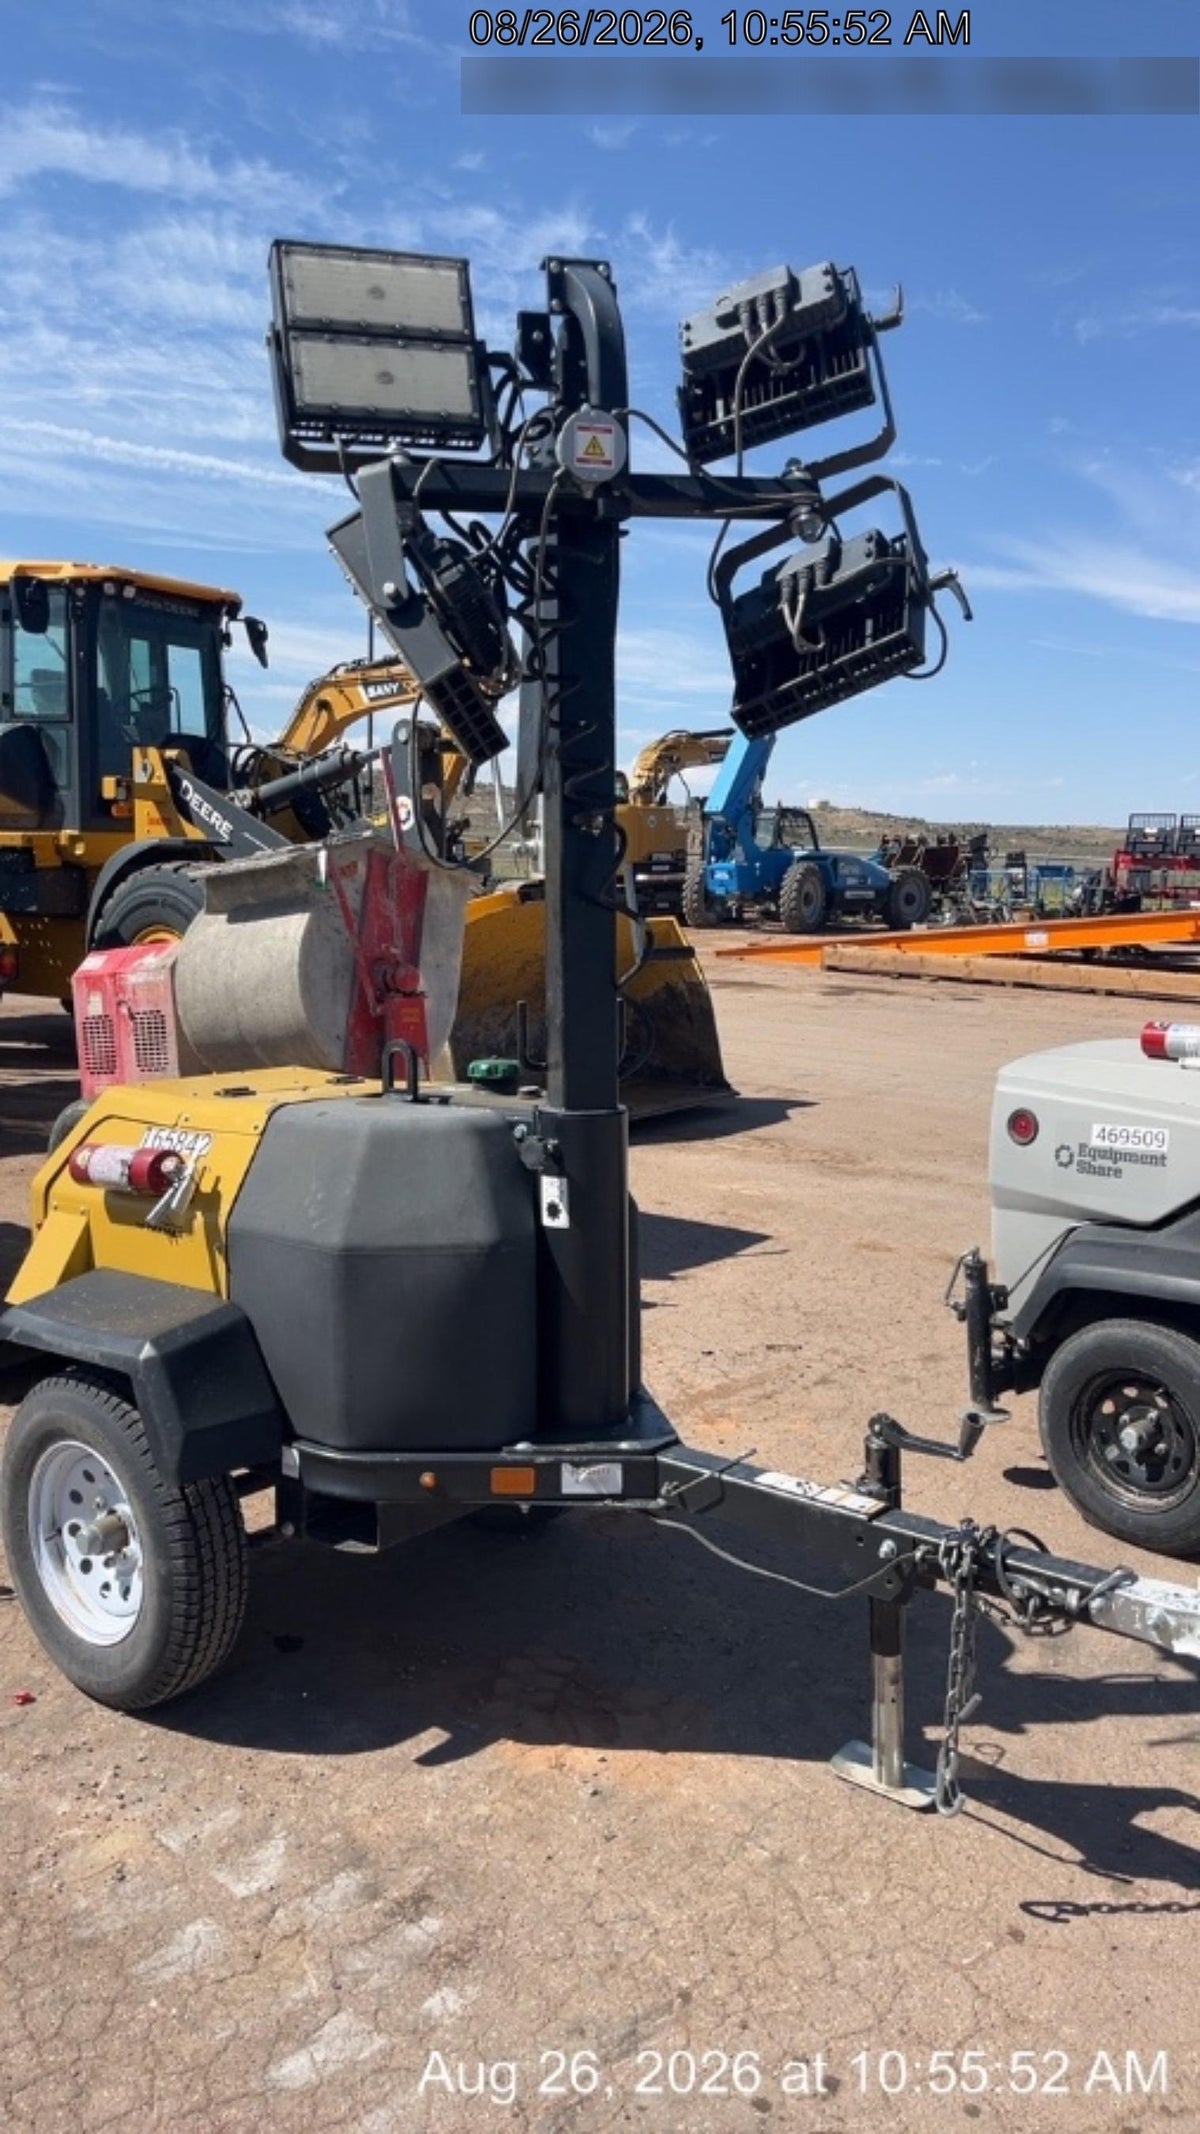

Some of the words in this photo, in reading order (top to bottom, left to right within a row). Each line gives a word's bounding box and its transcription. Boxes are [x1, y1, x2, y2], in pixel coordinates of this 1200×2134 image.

[181, 780, 234, 842] DEERE
[1095, 1127, 1166, 1148] 469509
[1077, 1143, 1168, 1168] Equipment
[1075, 1159, 1123, 1179] Share
